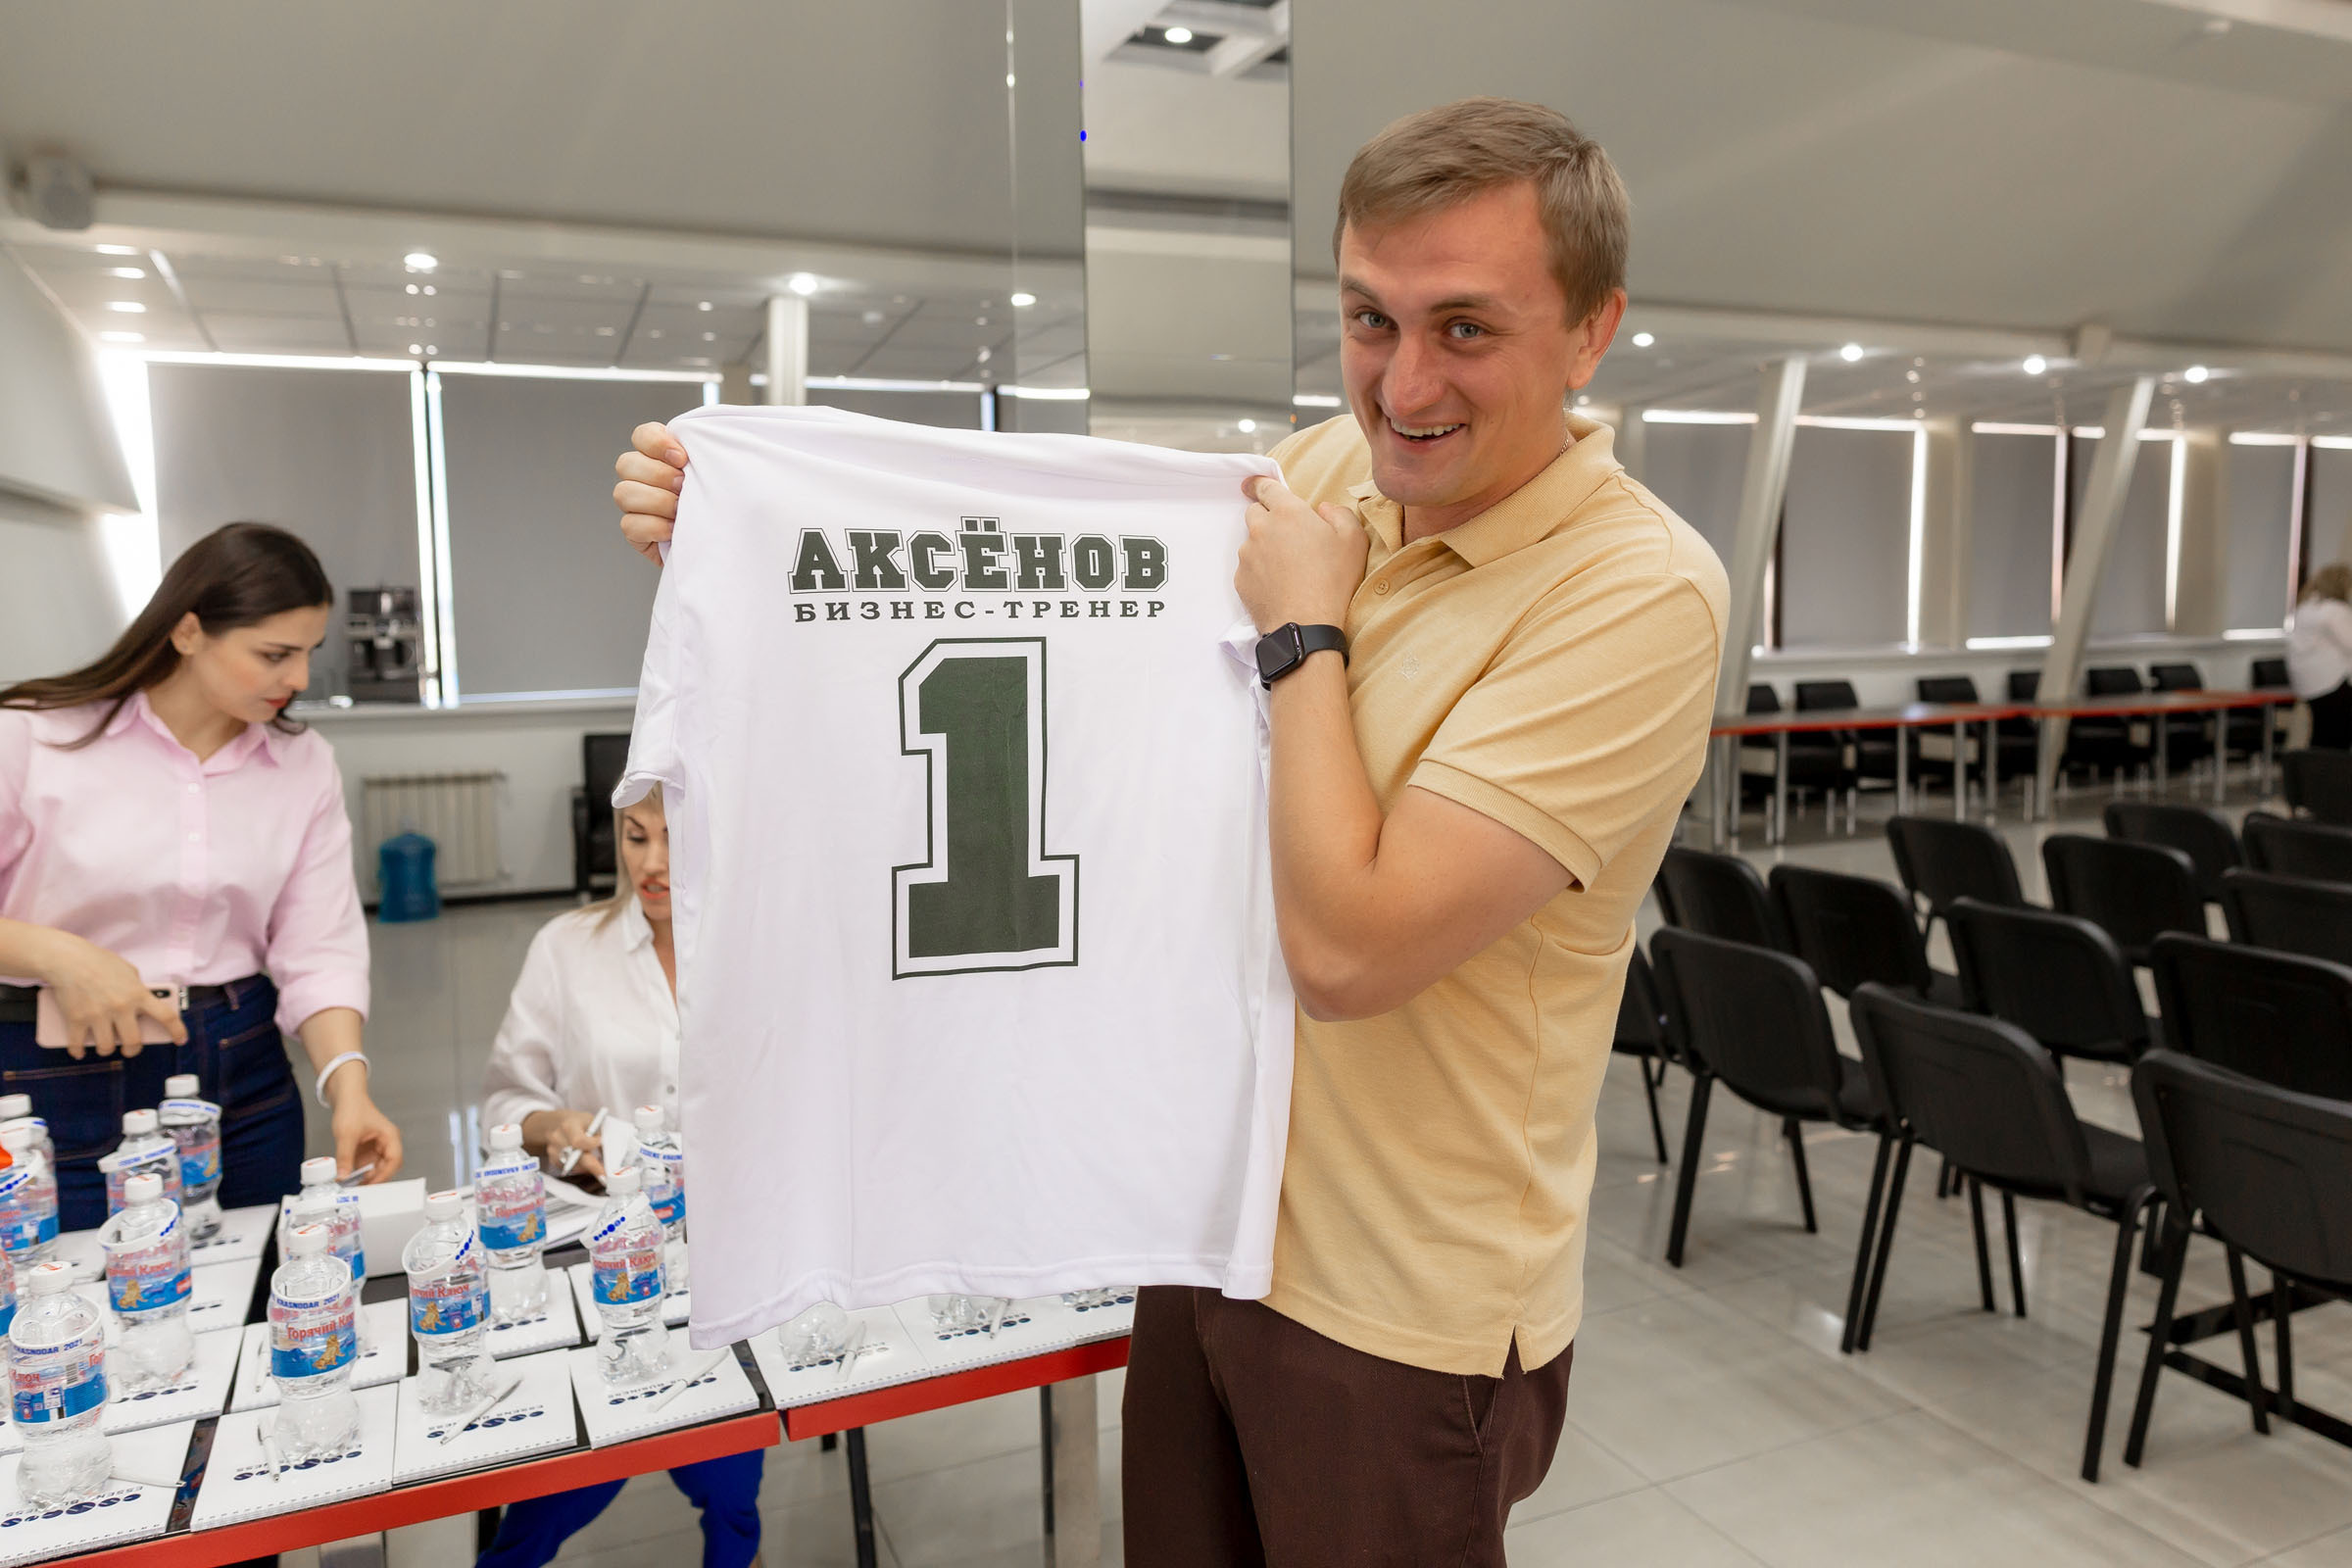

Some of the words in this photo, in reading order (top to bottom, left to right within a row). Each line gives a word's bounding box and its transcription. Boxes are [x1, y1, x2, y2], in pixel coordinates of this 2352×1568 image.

[788, 516, 1168, 594] АКСЁНОВ
[794, 601, 1165, 622] БИЗНЕС-ТРЕНЕР
[893, 637, 1079, 980] 1
[286, 1320, 337, 1343] Горячий
